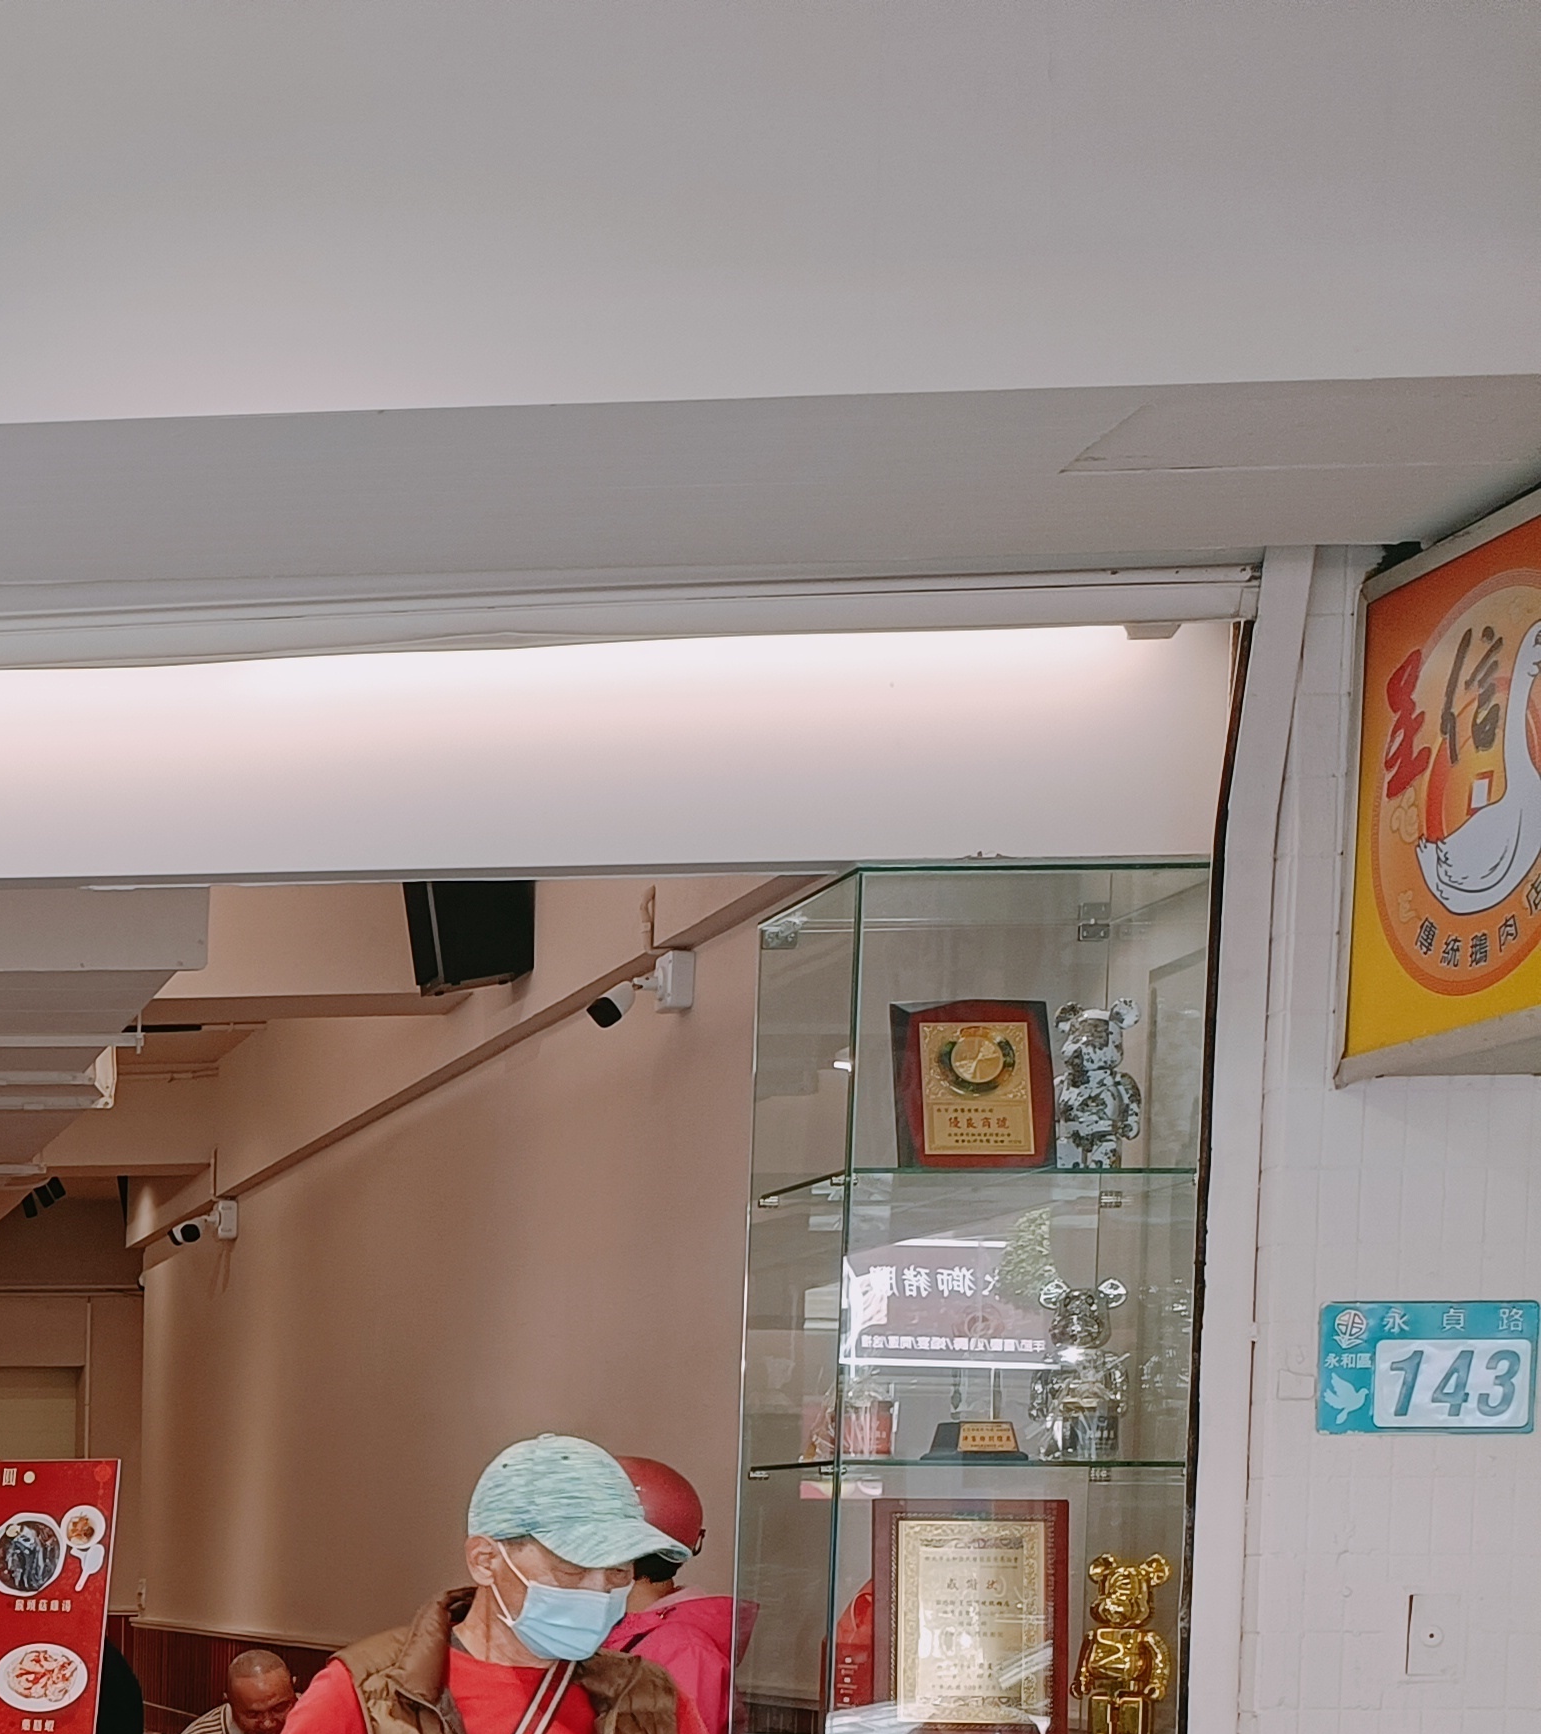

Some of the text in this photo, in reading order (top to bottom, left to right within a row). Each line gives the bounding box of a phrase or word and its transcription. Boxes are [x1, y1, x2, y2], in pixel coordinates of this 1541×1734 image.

[1383, 1308, 1524, 1334] 永貞路
[1324, 1353, 1372, 1369] 永和區
[1389, 1349, 1521, 1417] 143
